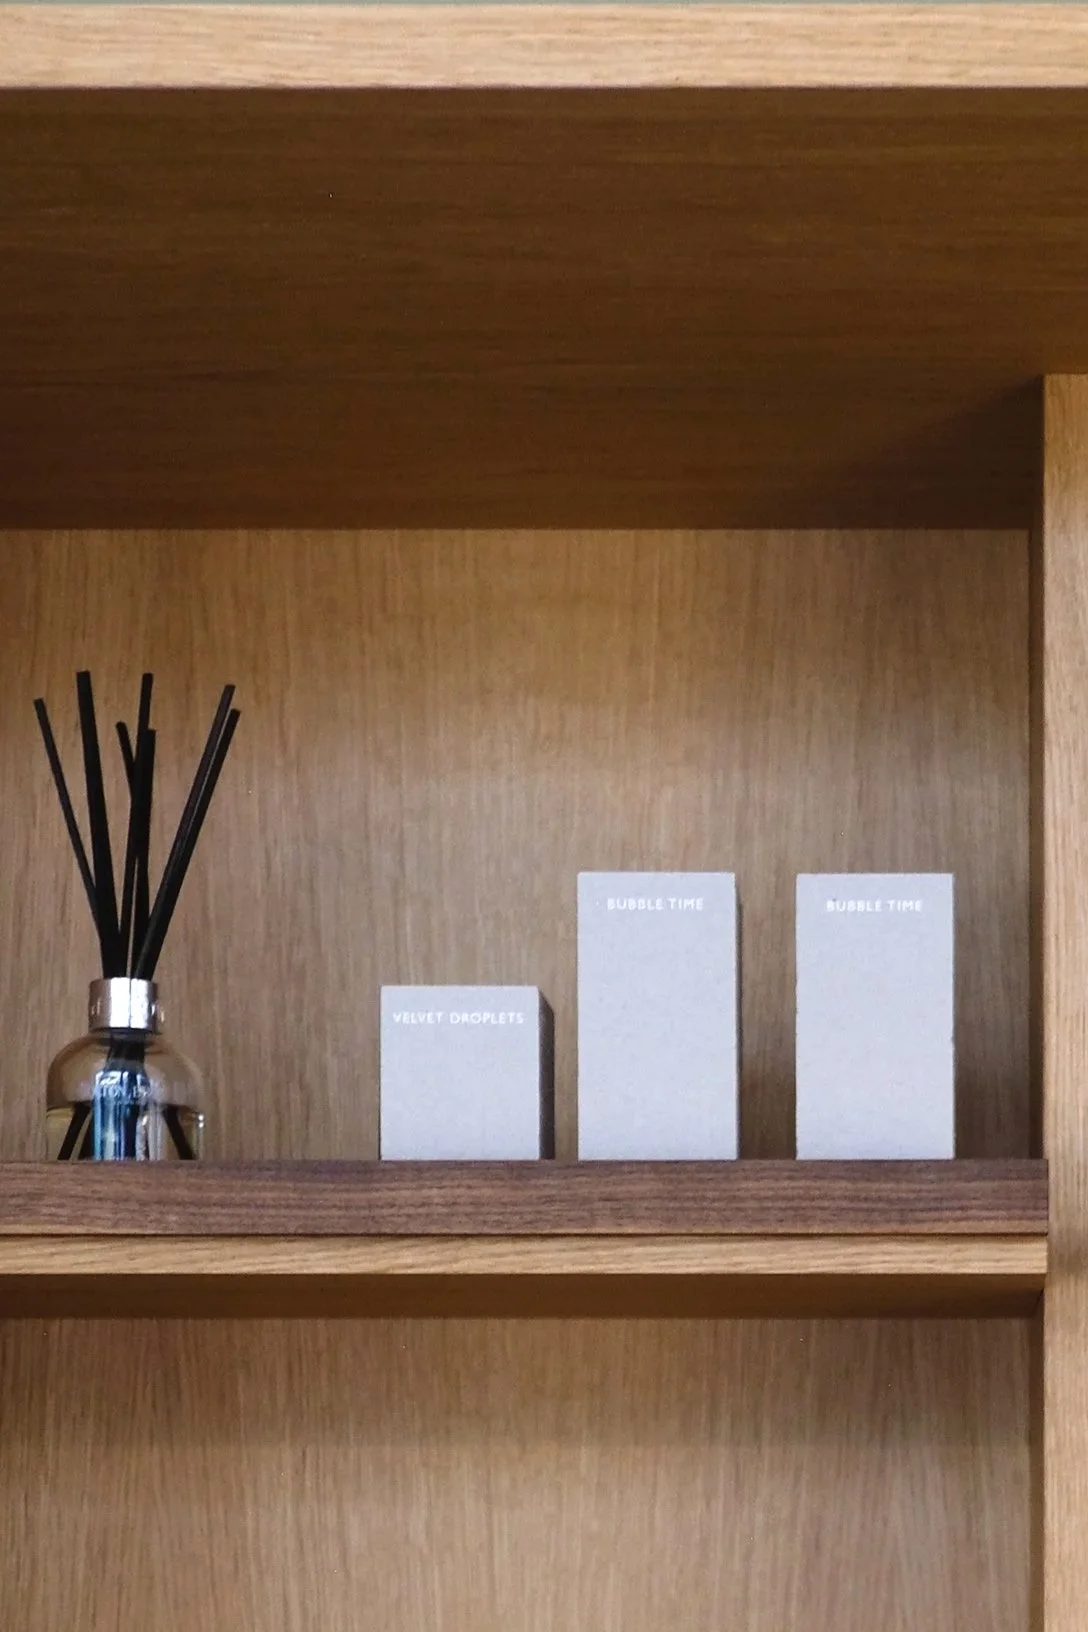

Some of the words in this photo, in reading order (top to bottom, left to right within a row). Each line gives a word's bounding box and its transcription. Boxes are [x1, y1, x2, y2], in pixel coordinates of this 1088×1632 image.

[607, 897, 664, 910] BUBBLE
[667, 897, 704, 910] TIME
[826, 899, 882, 912] BUBBLE
[888, 899, 922, 912] TIME
[393, 1011, 444, 1024] VELVET
[450, 1011, 525, 1024] DROPLETS
